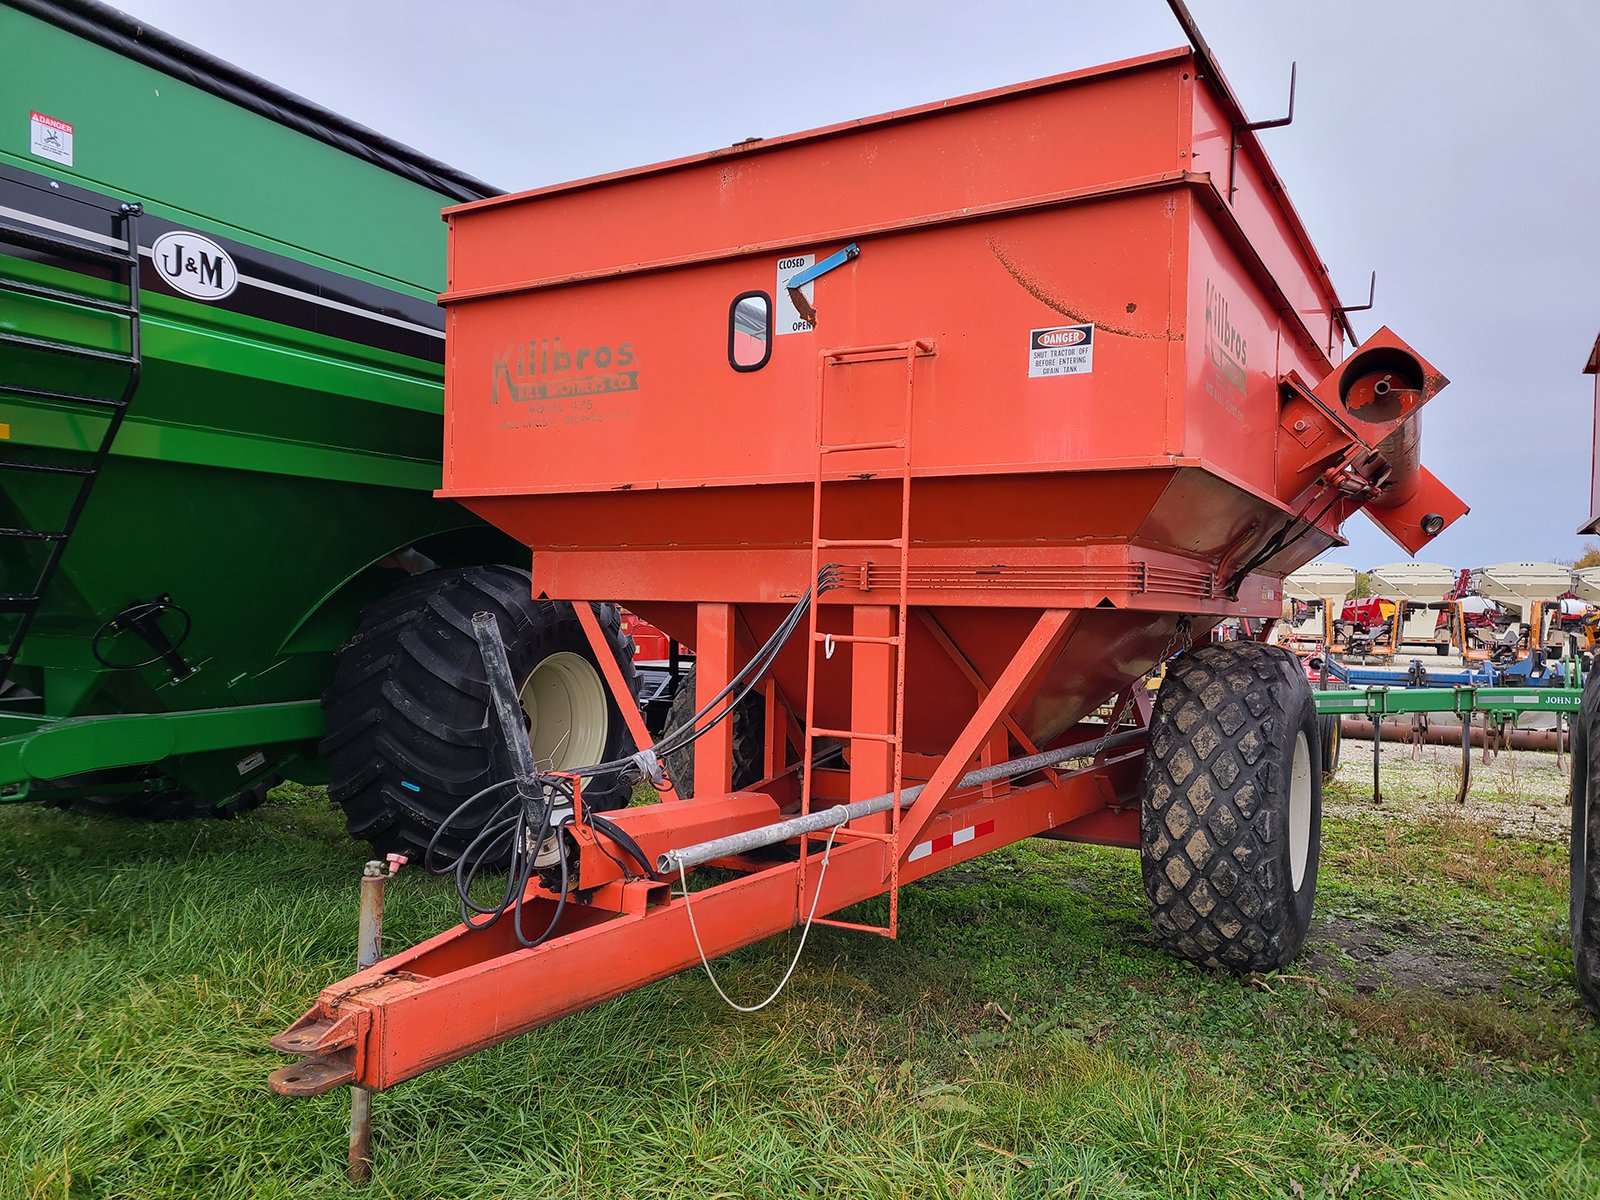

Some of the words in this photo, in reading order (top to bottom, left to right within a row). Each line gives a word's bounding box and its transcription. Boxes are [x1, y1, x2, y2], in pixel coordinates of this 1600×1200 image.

[39, 115, 72, 134] DANGER
[162, 243, 224, 290] J&M
[778, 257, 805, 270] CLOSED
[792, 321, 812, 331] OPEN
[1204, 277, 1247, 366] Killbros
[1044, 332, 1079, 344] DANGER
[1051, 349, 1075, 357] TRACTOR
[1078, 347, 1089, 355] OFF
[1035, 359, 1056, 367] BEFORE
[1059, 356, 1086, 365] ENTERING
[491, 337, 634, 404] Killbros
[1042, 367, 1060, 375] GRAIN
[1063, 365, 1078, 373] TANK
[517, 383, 541, 399] KILL
[1545, 696, 1571, 704] JOHN
